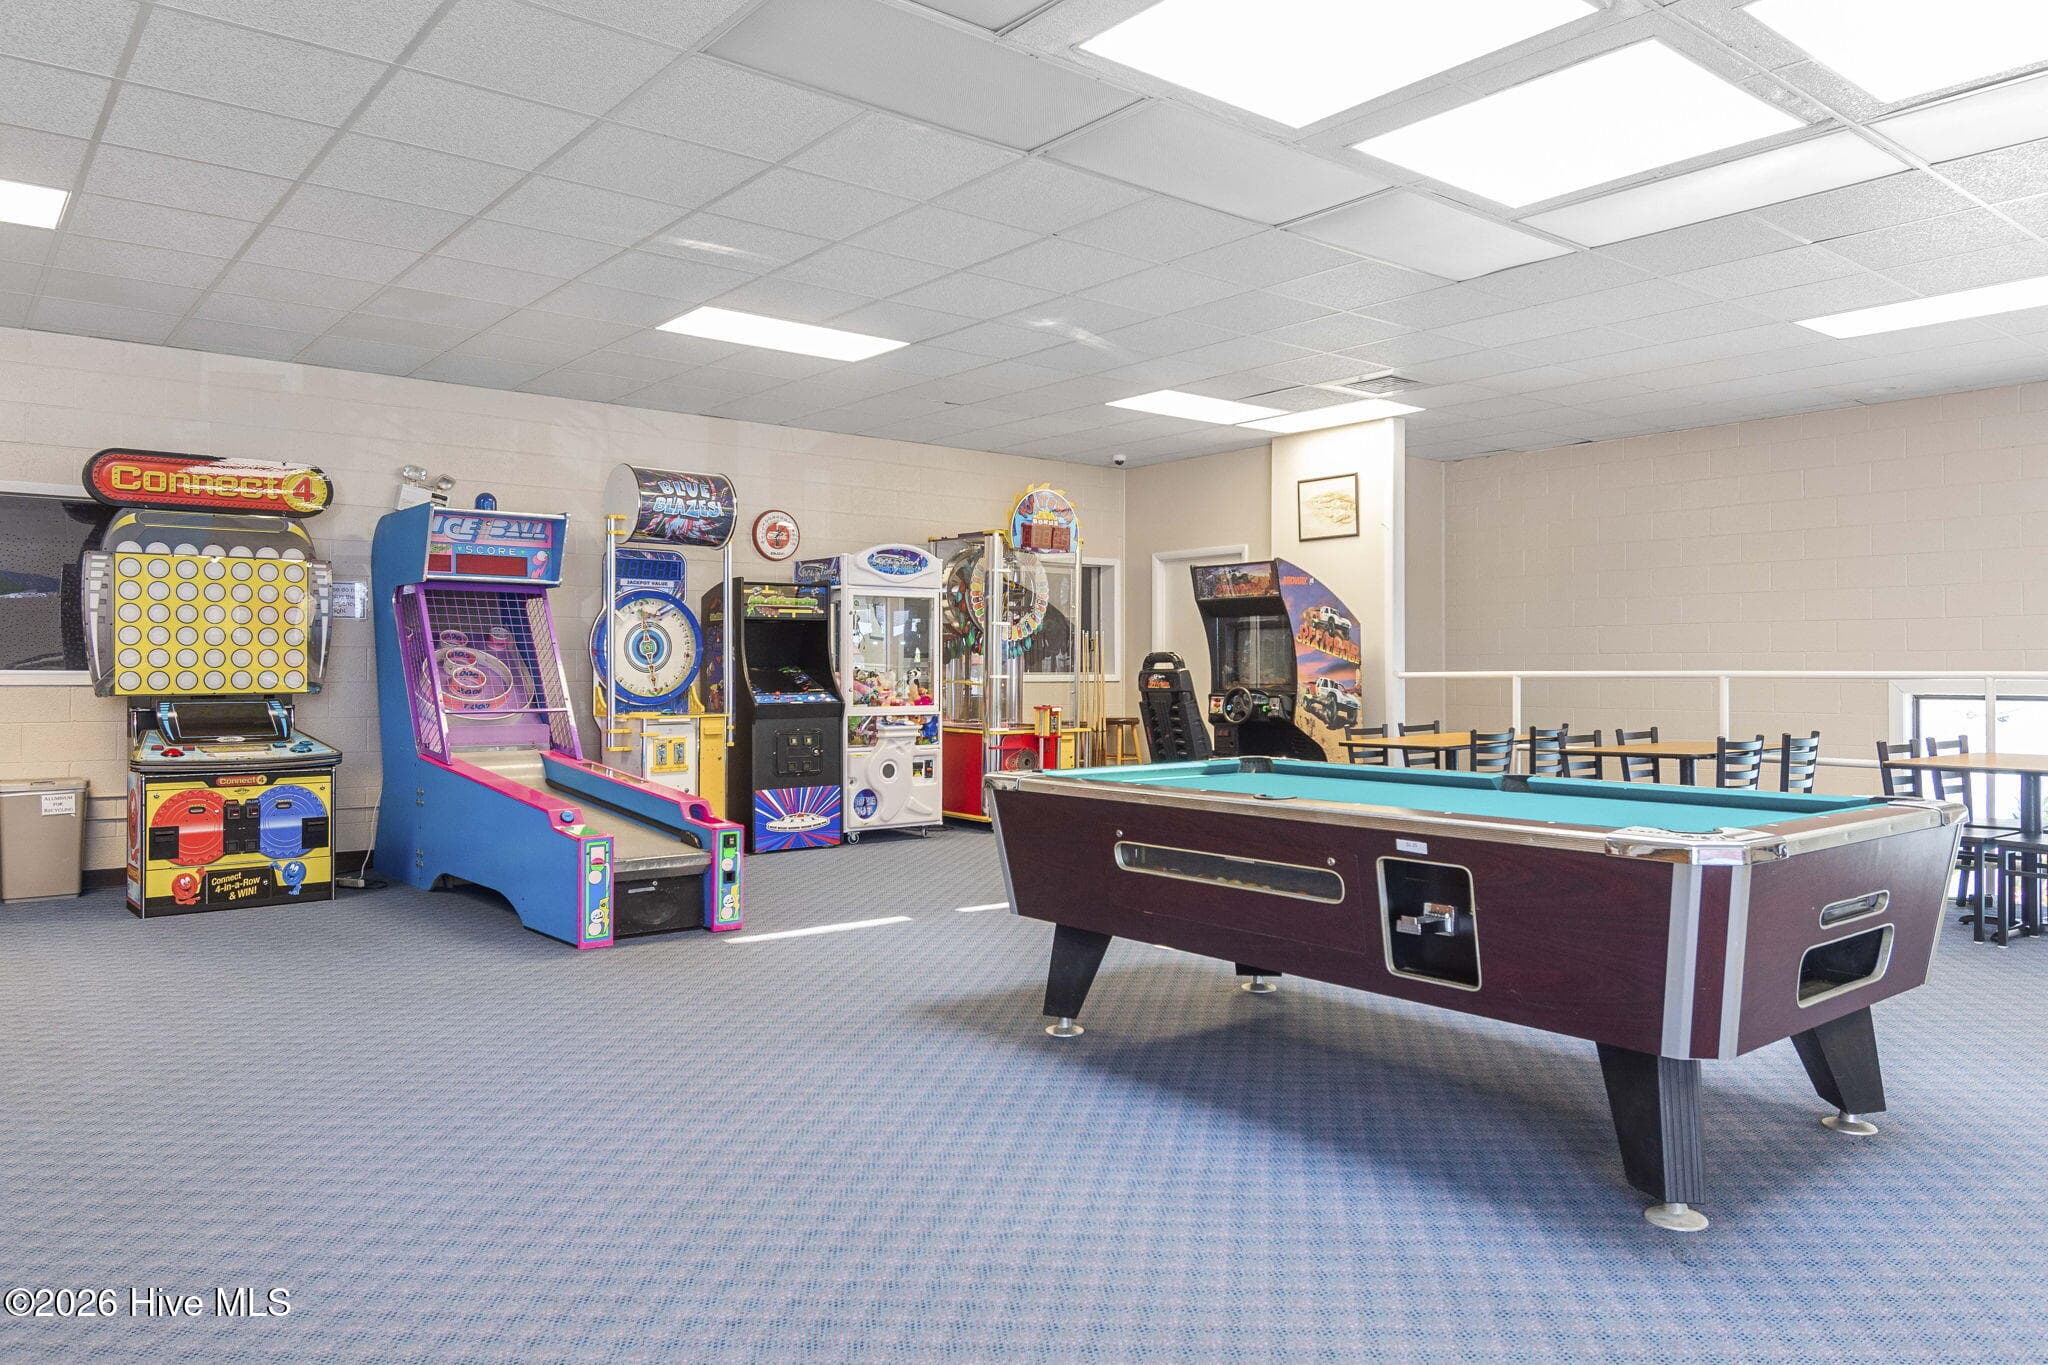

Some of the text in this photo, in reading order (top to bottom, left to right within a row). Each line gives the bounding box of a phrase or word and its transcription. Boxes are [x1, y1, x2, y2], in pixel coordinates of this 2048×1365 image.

[111, 465, 316, 503] Connect 4
[657, 481, 710, 498] BLUE
[431, 515, 546, 542] ICE BALL
[465, 545, 517, 555] SCORE
[219, 777, 256, 785] Connect
[211, 872, 242, 886] Connect
[214, 876, 261, 894] 4-in-a-Row
[229, 885, 257, 901] & WIN!
